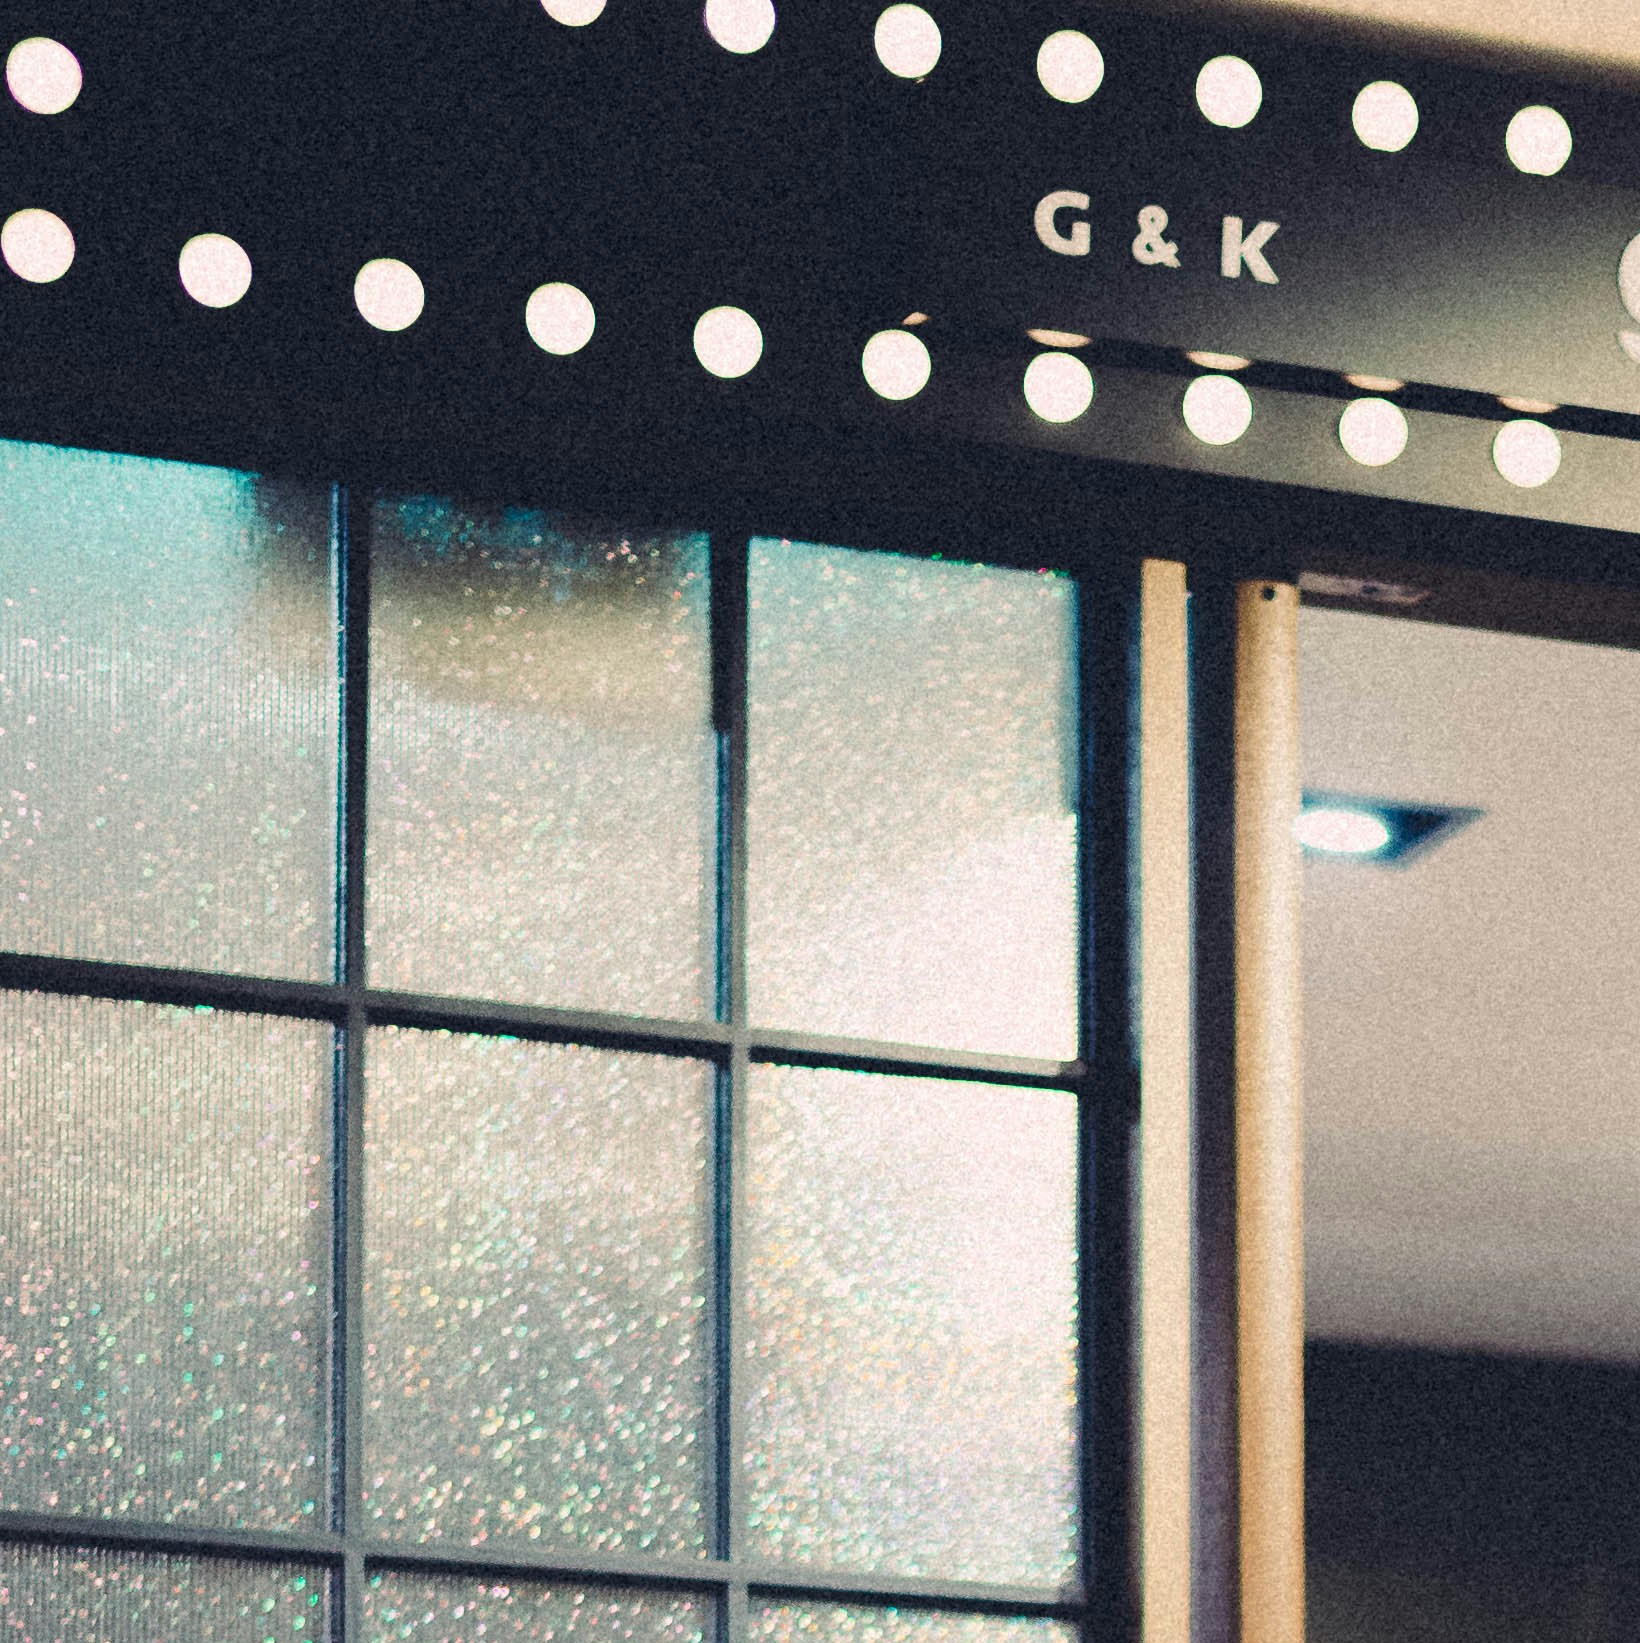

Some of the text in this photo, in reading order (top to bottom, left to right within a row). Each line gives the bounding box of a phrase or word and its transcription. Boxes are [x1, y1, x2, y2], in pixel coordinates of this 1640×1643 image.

[1033, 190, 1279, 284] G & K
